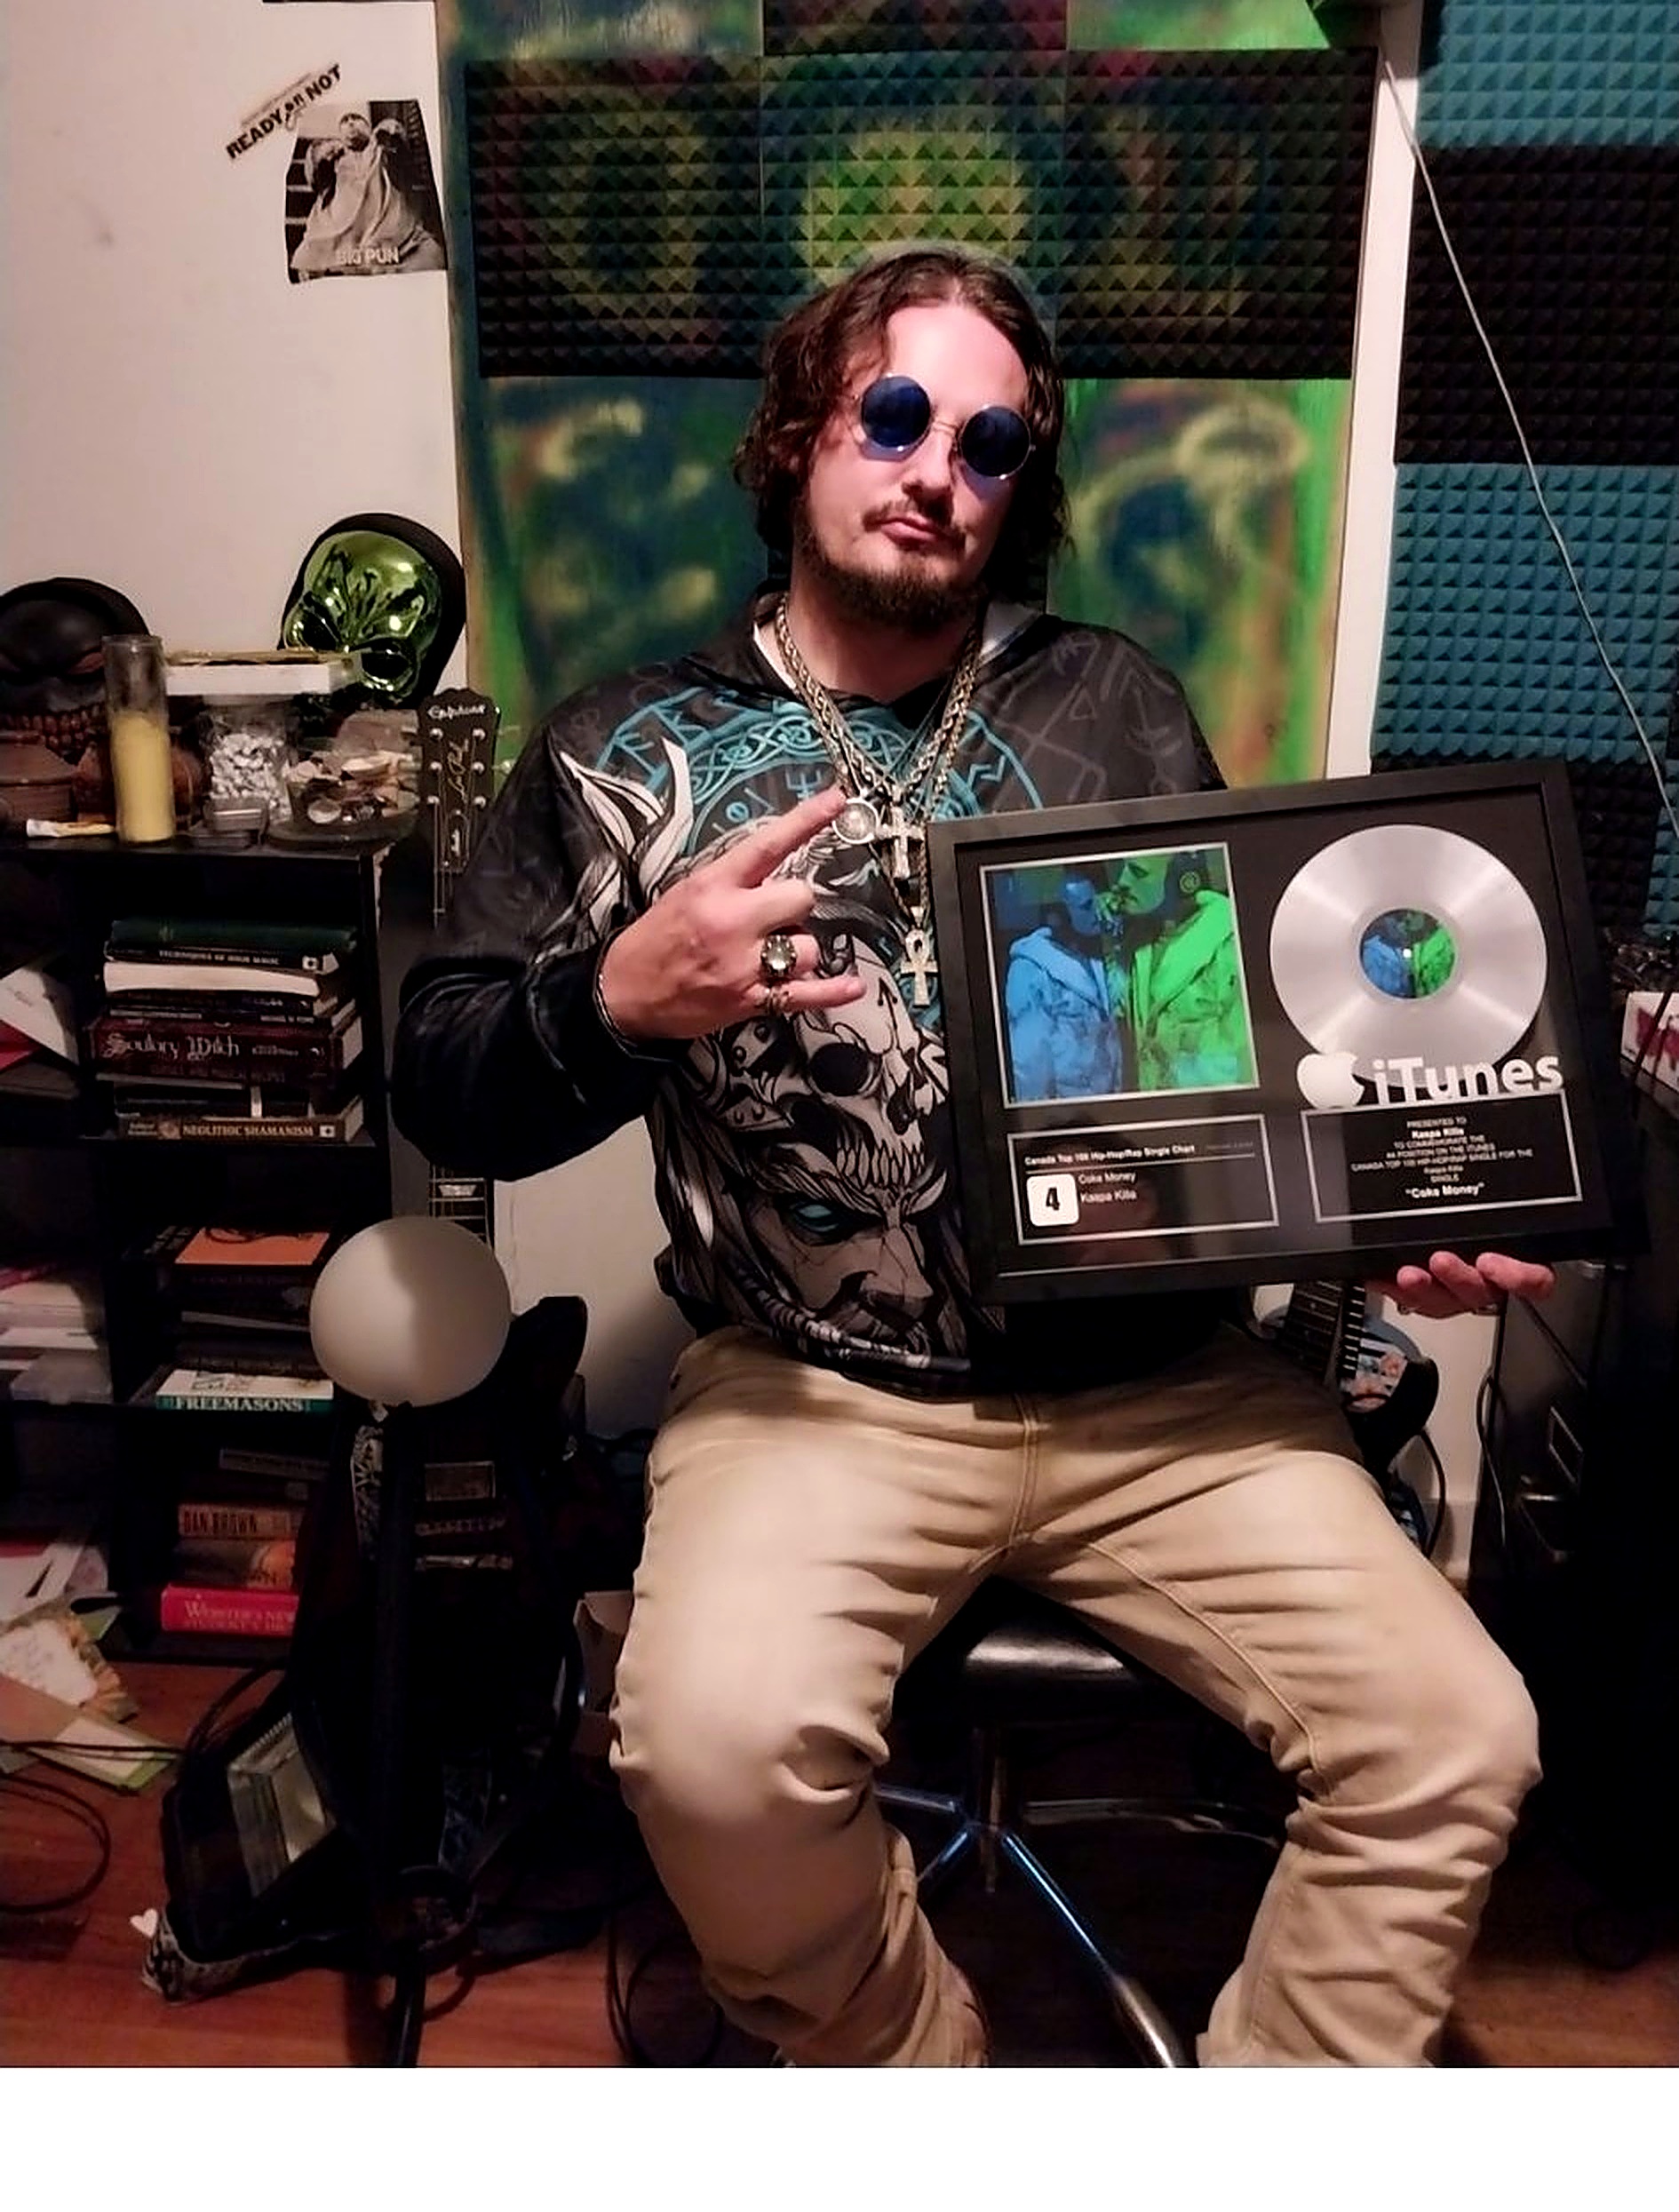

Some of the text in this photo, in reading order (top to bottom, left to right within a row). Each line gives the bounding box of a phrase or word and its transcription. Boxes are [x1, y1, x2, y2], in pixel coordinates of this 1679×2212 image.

[226, 107, 287, 160] READY
[305, 63, 341, 101] NOT
[336, 246, 400, 265] BIG PUN
[185, 1033, 241, 1062] Witch
[1371, 1055, 1564, 1106] iTunes
[182, 1124, 314, 1138] NEOLITHIC SHAMANISM
[1406, 1116, 1467, 1129] PRESENTED TO
[1397, 1149, 1435, 1158] POSITION
[1435, 1148, 1448, 1157] ON
[1449, 1145, 1465, 1154] THE
[1406, 1135, 1468, 1149] COMMEMORATE
[1469, 1134, 1485, 1143] THE
[1024, 1155, 1056, 1166] Canada
[1057, 1154, 1073, 1166] Top
[1091, 1149, 1142, 1162] Hip-Hop/Rap
[1143, 1146, 1170, 1158] Single
[1172, 1143, 1195, 1154] Chart
[1350, 1162, 1385, 1173] CANADA
[1385, 1160, 1402, 1169] TOP
[1468, 1152, 1498, 1163] SINGLE
[1499, 1150, 1516, 1159] FOR
[1516, 1149, 1533, 1158] THE
[1078, 1171, 1136, 1185] Coke Money
[1046, 1187, 1061, 1212] 4
[176, 1397, 305, 1413] FREEMASONS
[183, 1511, 209, 1534] DAN
